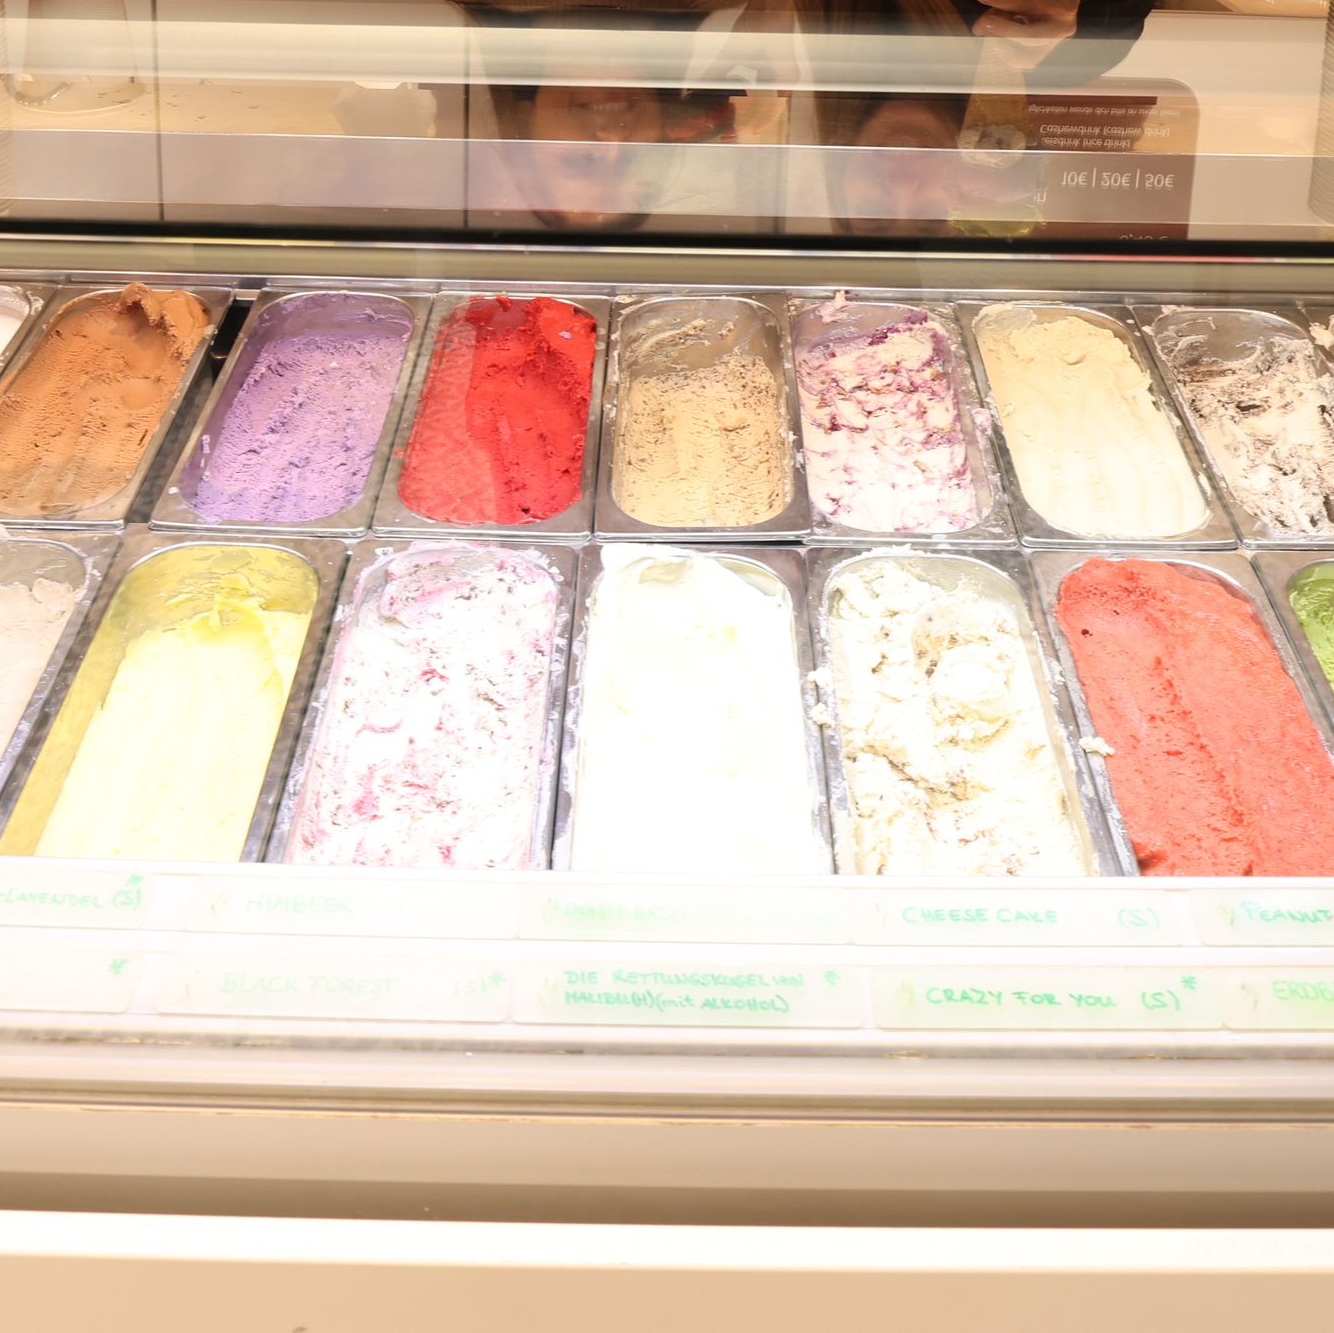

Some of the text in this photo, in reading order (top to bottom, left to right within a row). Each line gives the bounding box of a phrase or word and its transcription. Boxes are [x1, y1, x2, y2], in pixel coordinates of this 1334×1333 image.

[901, 907, 988, 924] CHEESE
[996, 908, 1058, 925] CAKE
[1240, 901, 1333, 924] PEANUT
[564, 970, 599, 985] DIE
[926, 988, 1003, 1007] CRAZY
[1013, 989, 1061, 1008] FOR
[1069, 993, 1117, 1009] YOU
